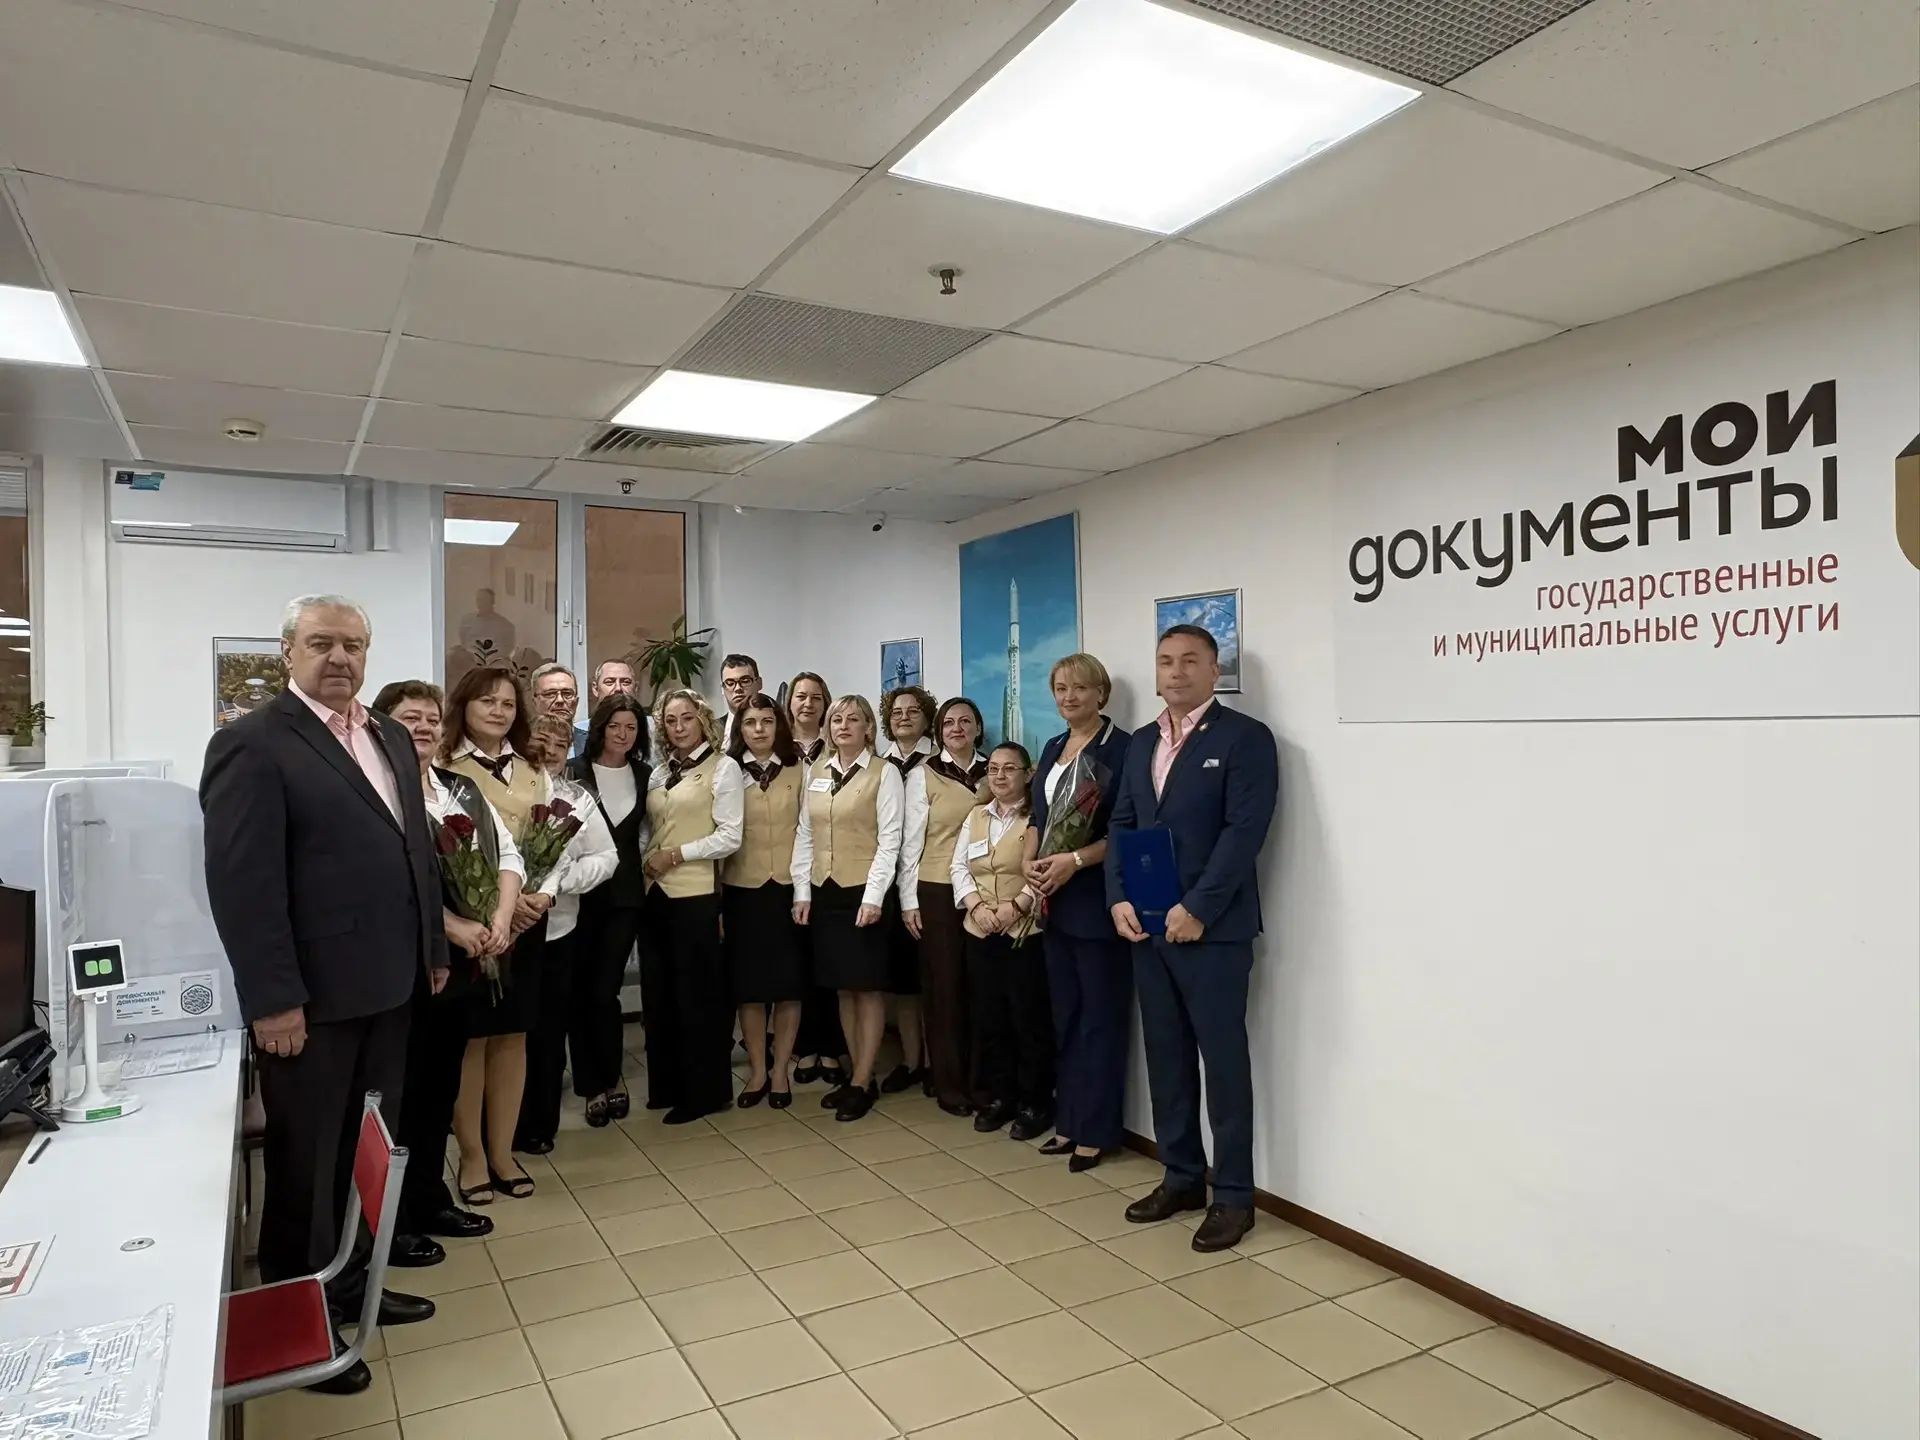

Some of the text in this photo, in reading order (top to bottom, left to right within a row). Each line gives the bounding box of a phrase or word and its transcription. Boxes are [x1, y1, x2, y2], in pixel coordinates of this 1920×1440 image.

[1536, 553, 1839, 611] государственные
[1434, 602, 1839, 663] и муниципальные услуги
